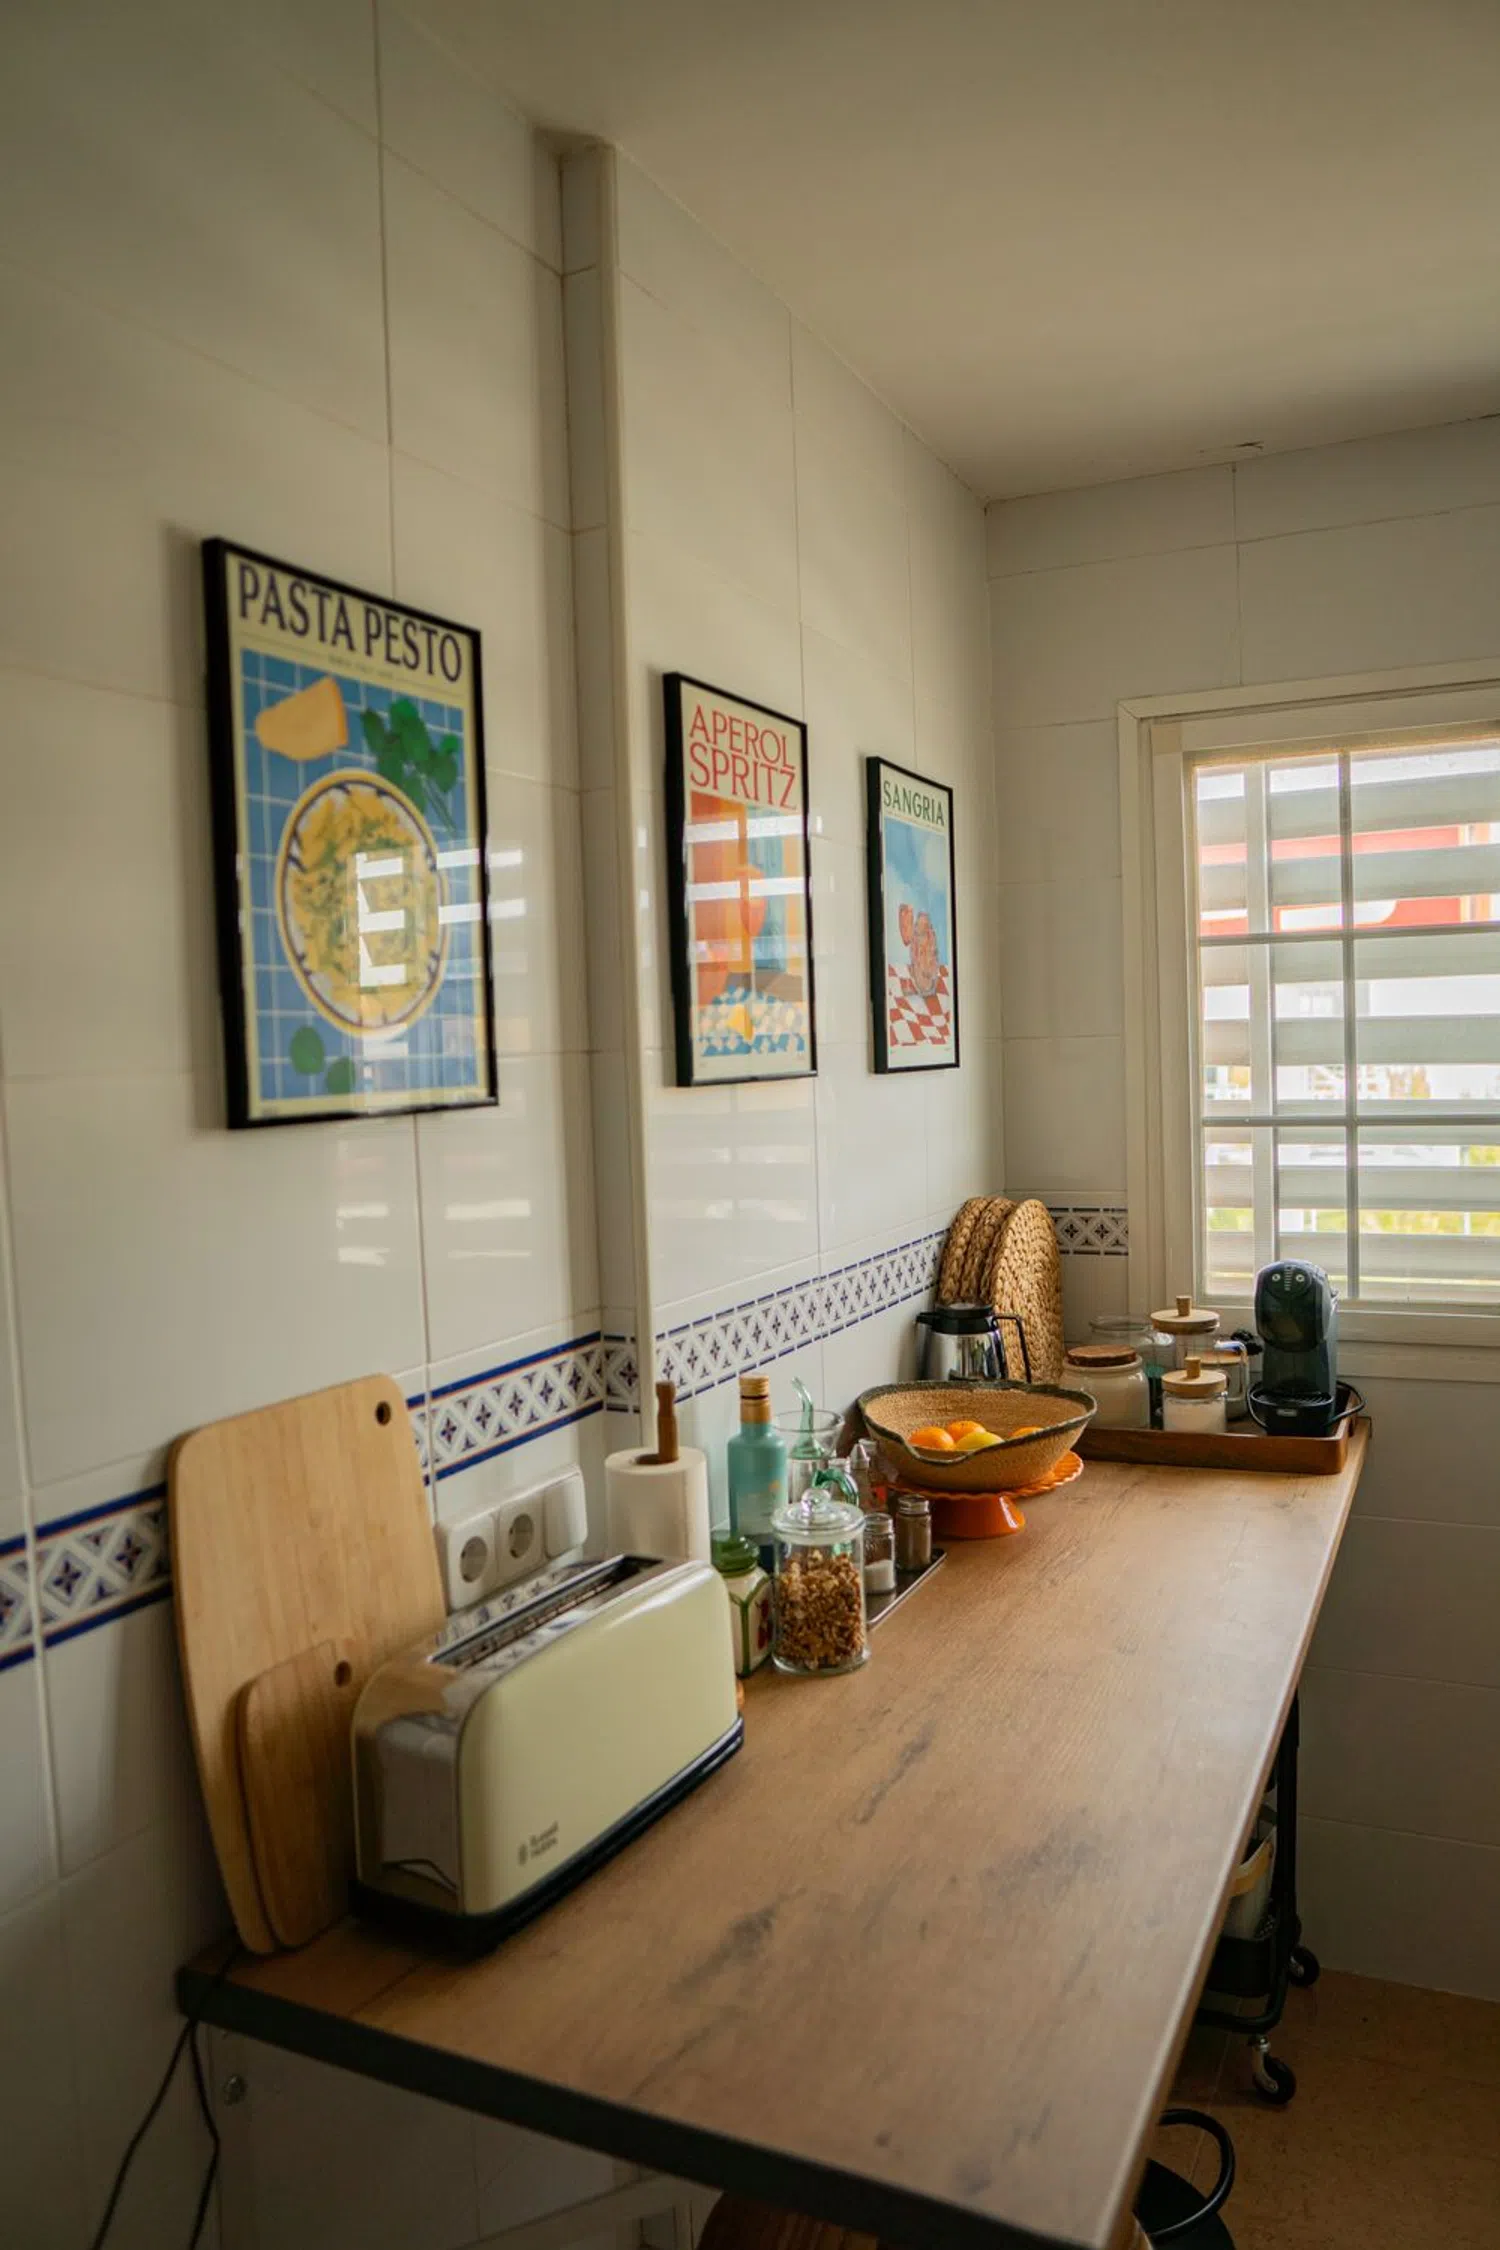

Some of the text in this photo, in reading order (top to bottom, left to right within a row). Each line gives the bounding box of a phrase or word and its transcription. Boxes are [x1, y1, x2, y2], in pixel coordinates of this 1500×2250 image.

[239, 562, 462, 682] PASTA PESTO
[689, 704, 796, 770] APEROL
[689, 741, 797, 810] SPRITZ
[883, 780, 945, 827] SANGRIA
